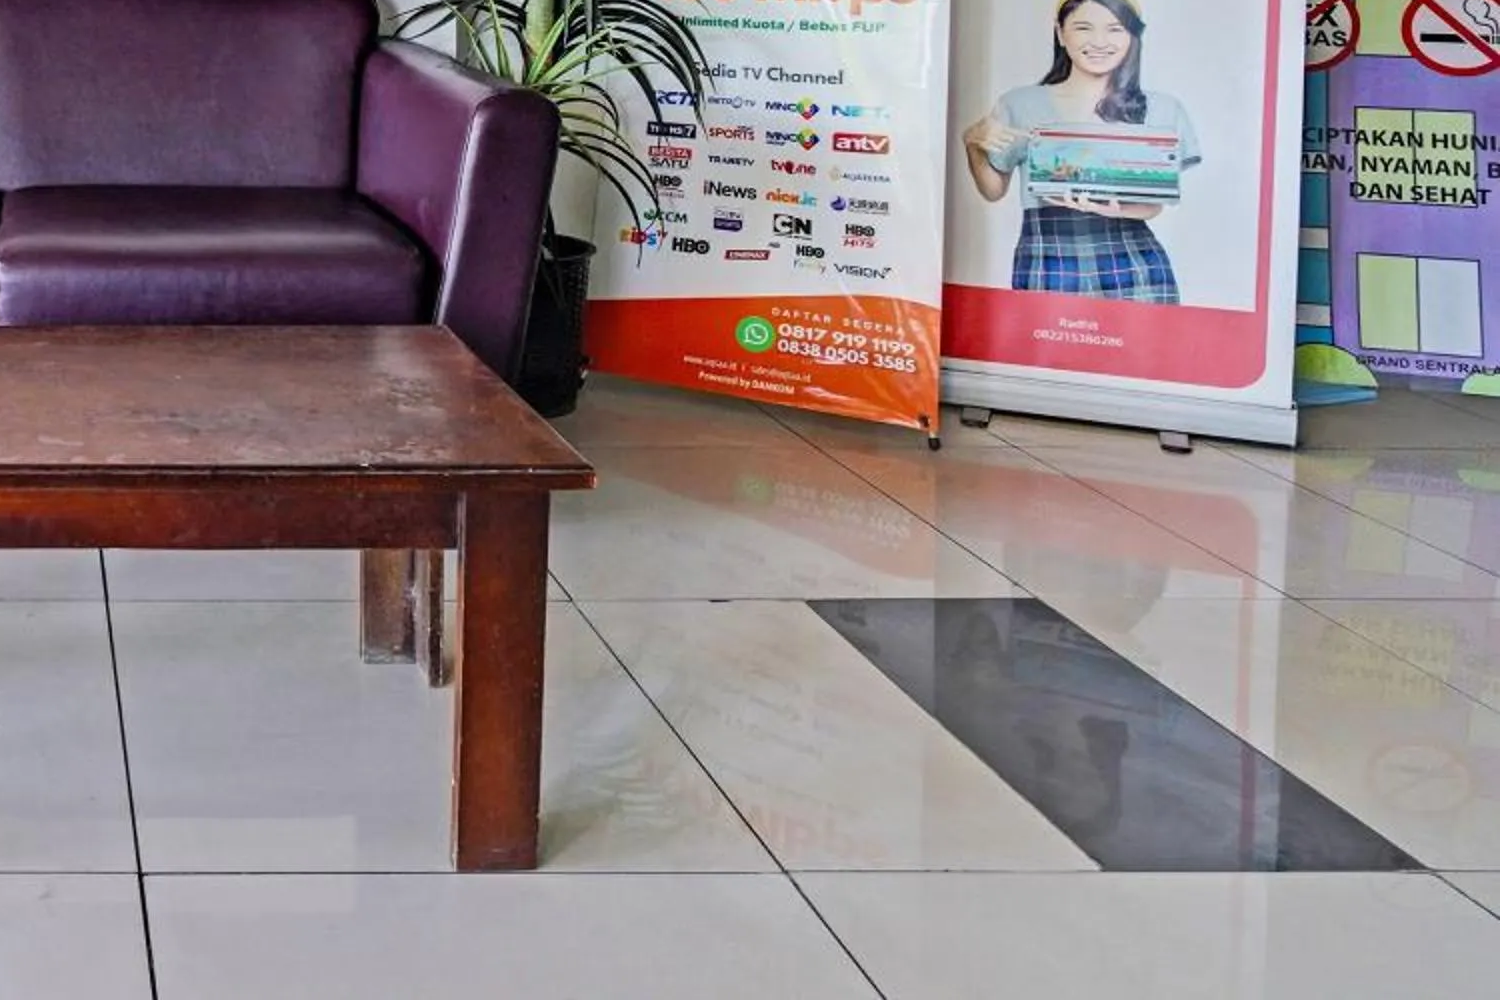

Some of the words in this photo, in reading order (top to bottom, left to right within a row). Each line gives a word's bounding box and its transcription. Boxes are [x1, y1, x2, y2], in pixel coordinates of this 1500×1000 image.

[742, 18, 785, 30] Kuota
[742, 66, 763, 80] TV
[766, 67, 844, 85] Channel
[1431, 132, 1500, 152] HUNI
[1361, 155, 1478, 180] NYAMAN,
[703, 179, 757, 200] iNews
[1350, 181, 1403, 200] DAN
[1411, 184, 1492, 205] SEHAT
[672, 236, 710, 254] HBO
[796, 244, 825, 258] HBO
[778, 323, 828, 342] 0817
[832, 332, 867, 348] 919
[871, 338, 915, 356] 1199
[777, 339, 821, 357] 0838
[825, 346, 869, 364] 0505
[873, 354, 917, 373] 3585
